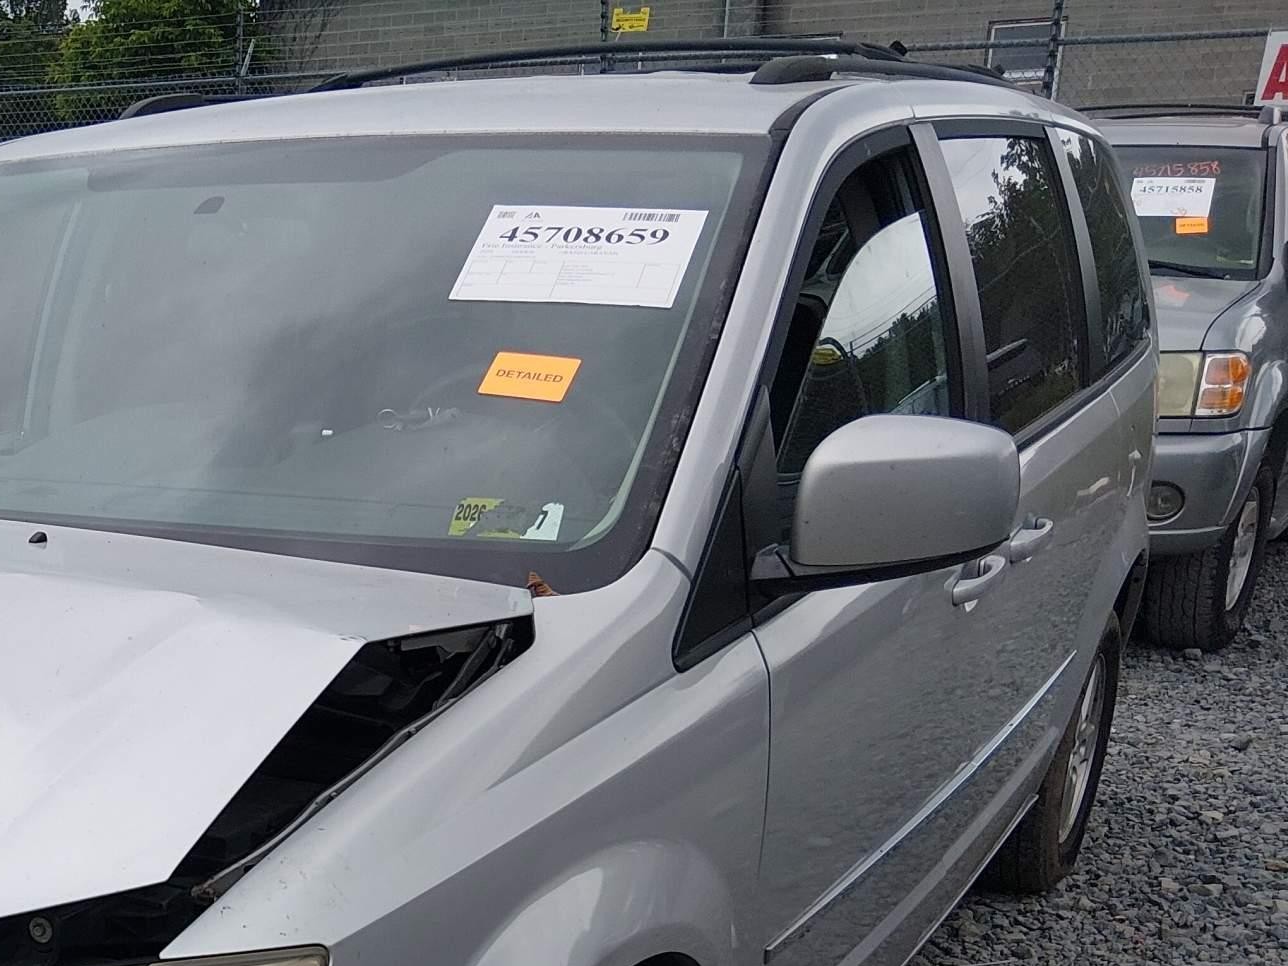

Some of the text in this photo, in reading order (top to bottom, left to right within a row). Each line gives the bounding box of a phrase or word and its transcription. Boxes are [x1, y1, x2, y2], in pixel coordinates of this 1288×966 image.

[1140, 185, 1204, 194] 45715858
[498, 226, 670, 246] 45708659
[495, 367, 564, 384] DETAILED
